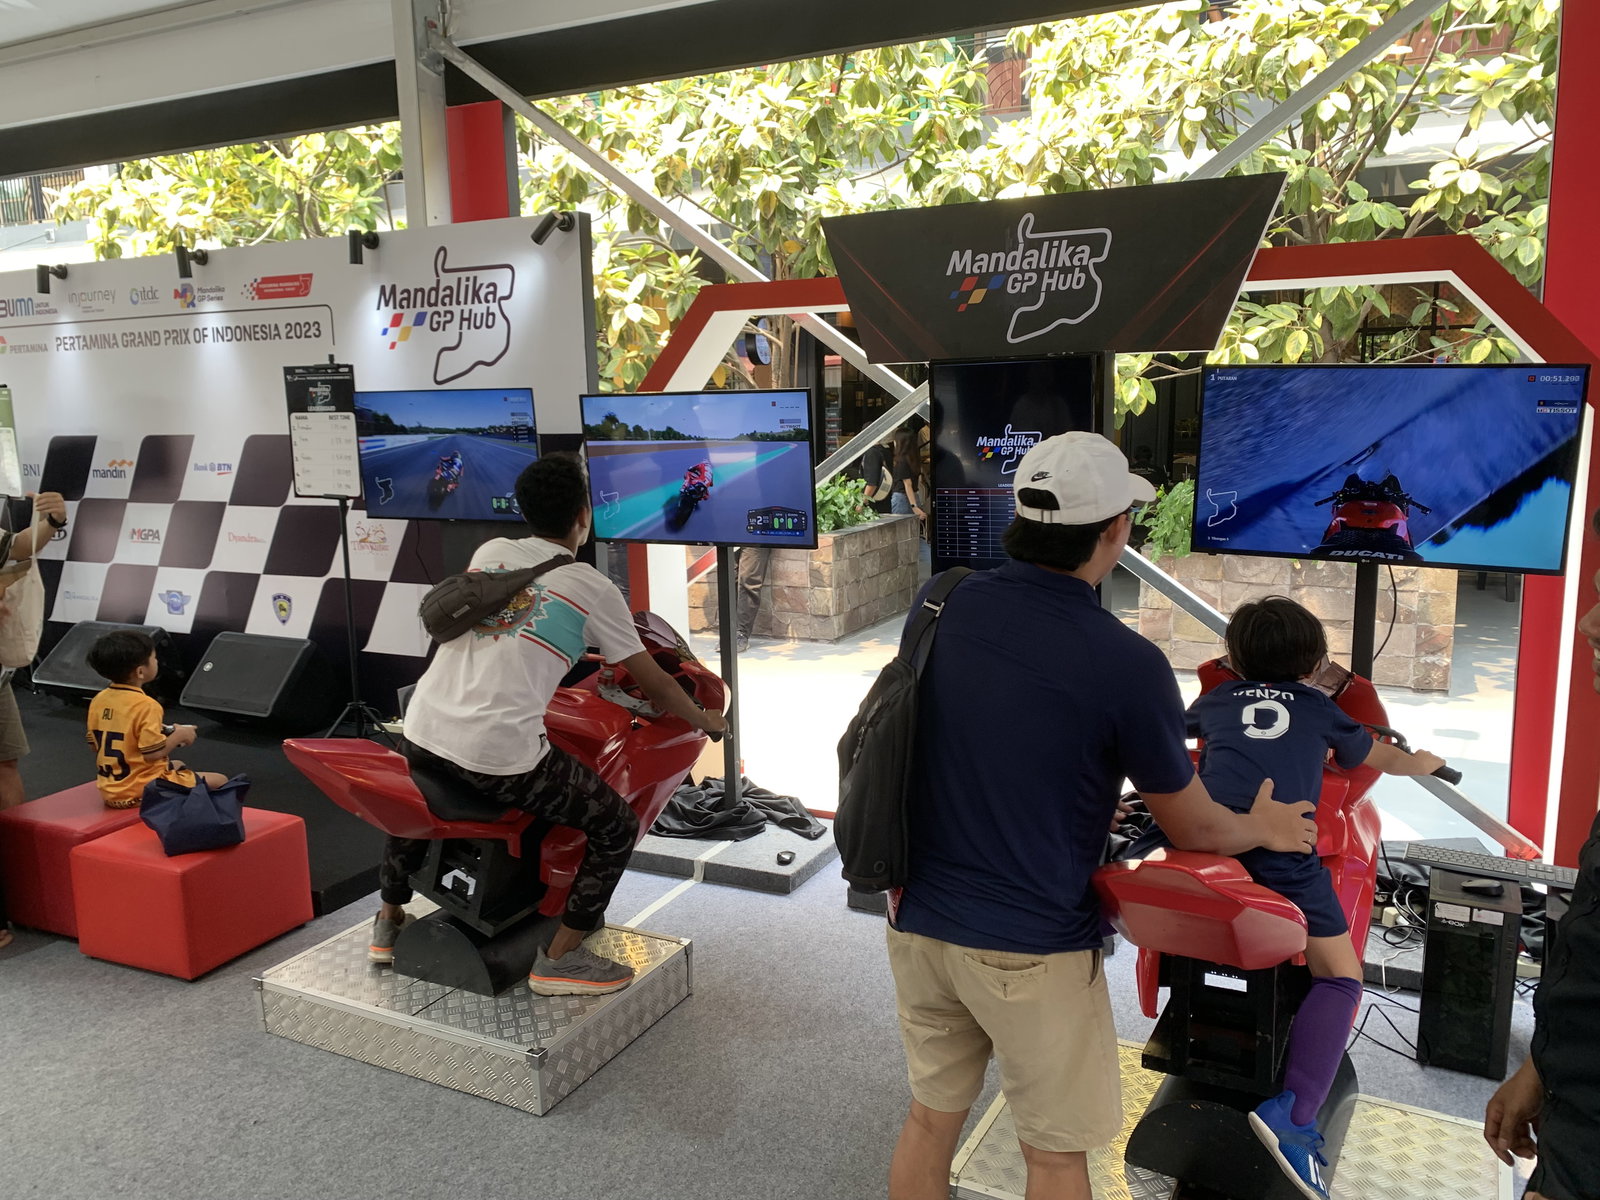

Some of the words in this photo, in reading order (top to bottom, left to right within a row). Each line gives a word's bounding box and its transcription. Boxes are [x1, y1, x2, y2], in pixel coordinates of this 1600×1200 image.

[946, 240, 1090, 276] Mandalika
[1006, 271, 1037, 294] GP
[1041, 267, 1086, 292] Hub
[376, 276, 498, 310] Mandalika
[429, 310, 454, 332] GP
[459, 306, 496, 331] Hub
[55, 333, 119, 352] PERTAMINA
[121, 330, 161, 348] GRAND
[164, 328, 191, 346] PRIX
[193, 327, 208, 344] OF
[212, 323, 282, 343] INDONESIA
[285, 321, 322, 339] 2023
[9, 343, 48, 354] PERTAMINA
[976, 435, 1034, 447] Mandalika
[1001, 447, 1014, 455] GP
[23, 464, 41, 477] BNI
[217, 463, 232, 471] BTN
[130, 529, 160, 541] MGPA
[1329, 550, 1404, 561] DUCATI
